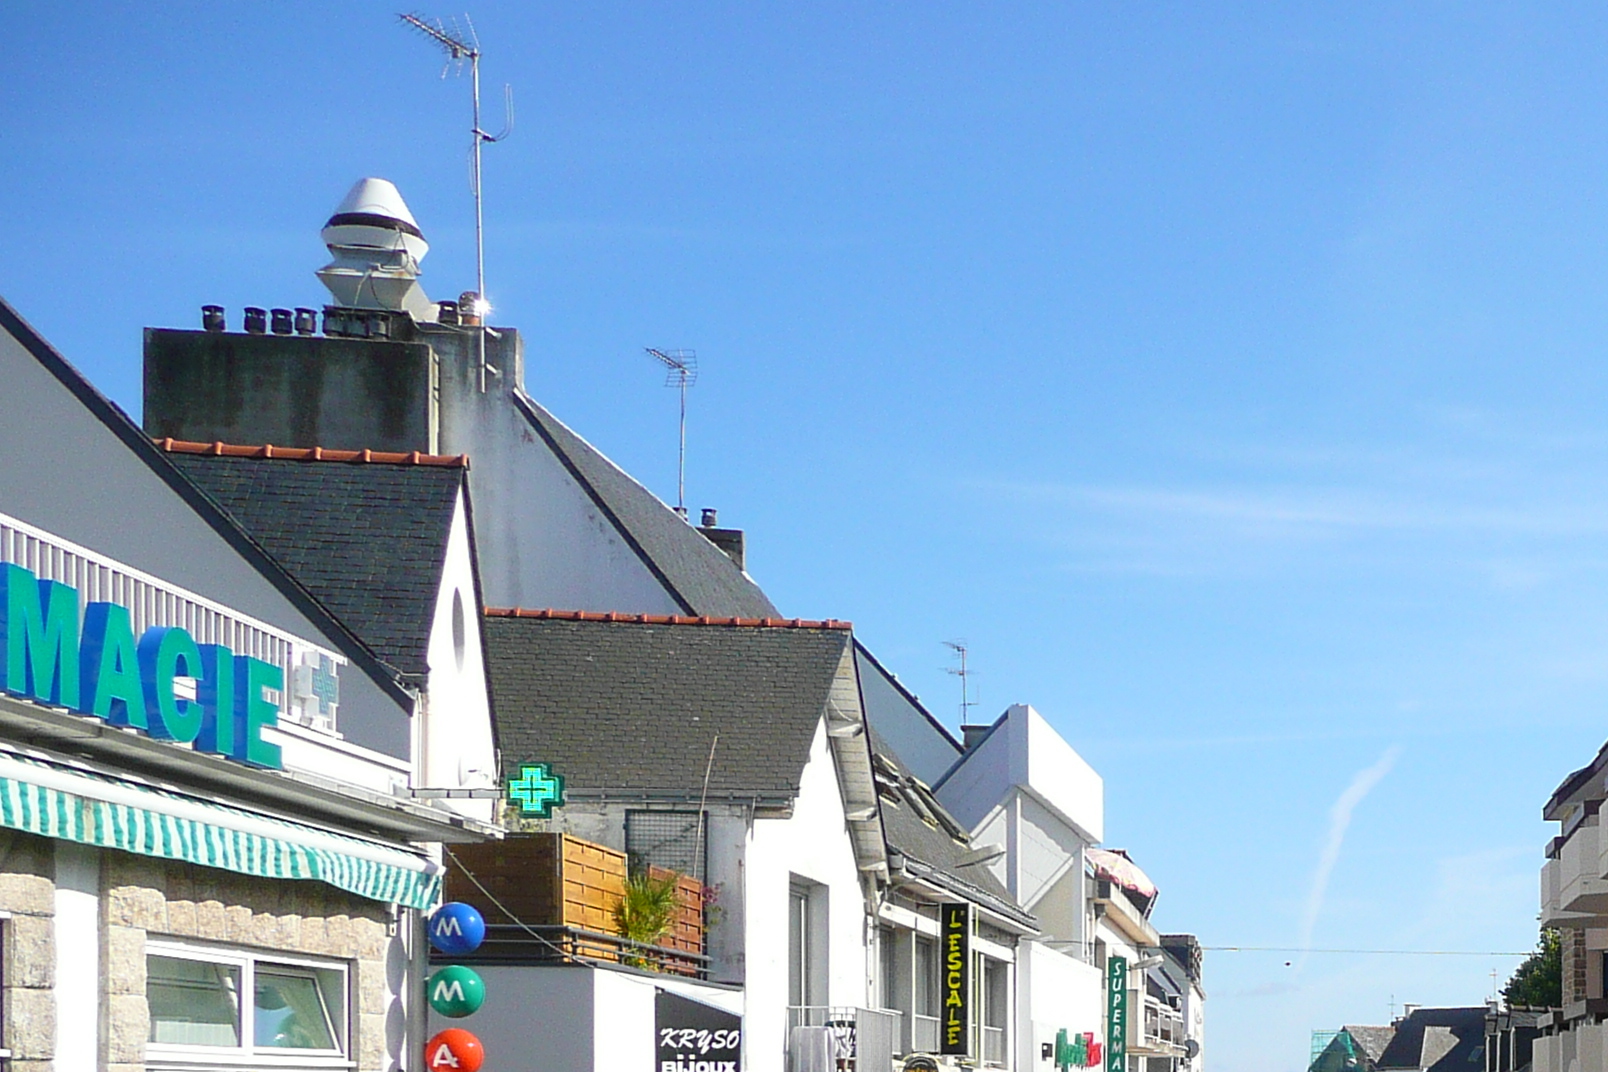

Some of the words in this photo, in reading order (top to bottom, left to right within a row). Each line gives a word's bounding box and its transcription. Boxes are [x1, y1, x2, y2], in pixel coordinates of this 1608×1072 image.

[0, 562, 284, 770] MACIE
[660, 1027, 740, 1054] KRYSO
[946, 909, 966, 1046] L'ESCALE
